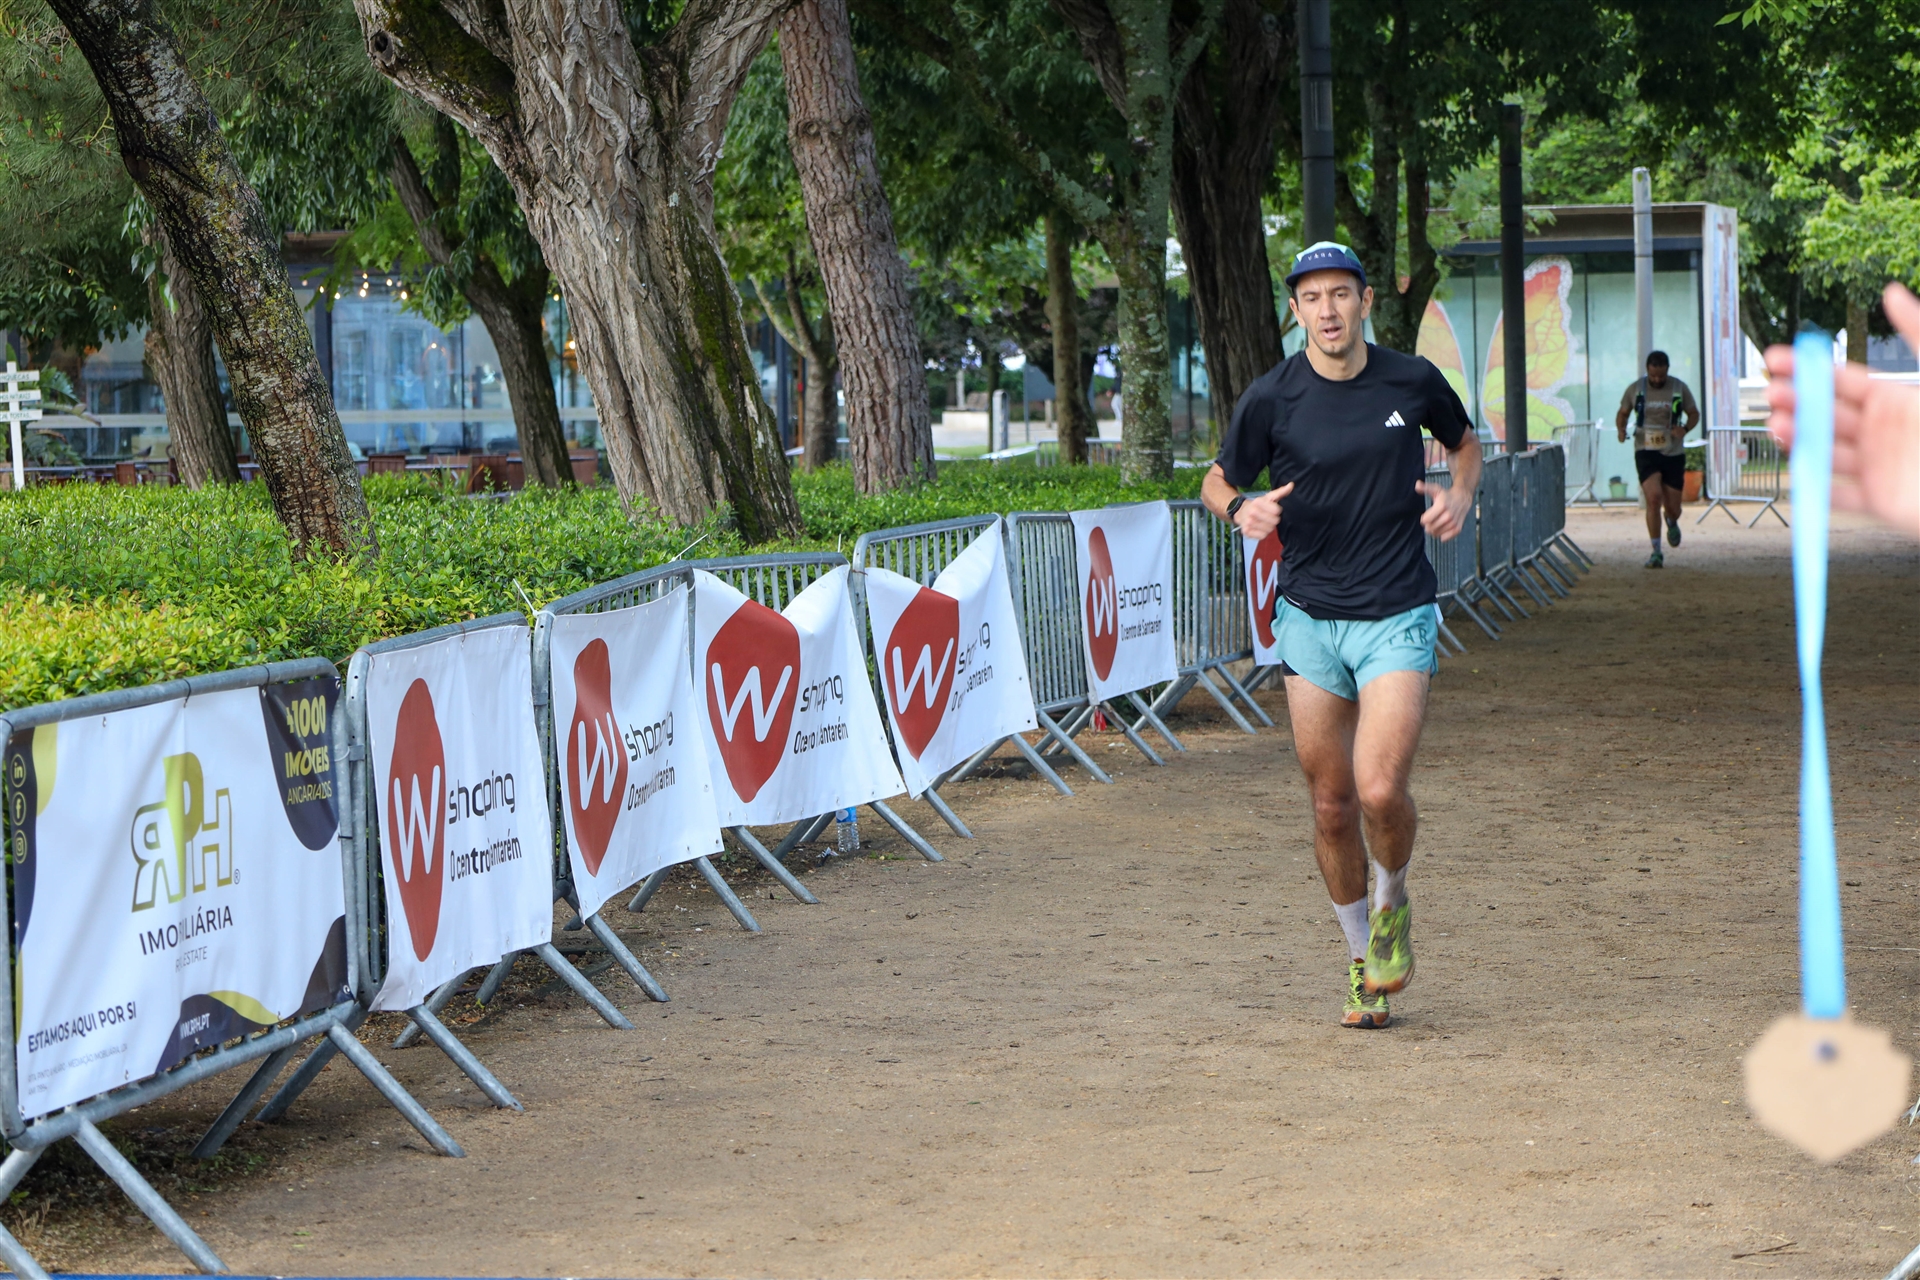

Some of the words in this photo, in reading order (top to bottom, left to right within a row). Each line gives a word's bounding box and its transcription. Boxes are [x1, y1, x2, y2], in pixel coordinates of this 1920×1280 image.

[1092, 574, 1114, 638] W
[1119, 581, 1161, 610] shopping
[711, 662, 793, 742] W
[893, 637, 954, 714] W
[578, 712, 619, 810] W
[394, 765, 441, 882] W
[449, 769, 515, 824] shoping
[628, 783, 635, 811] O
[450, 850, 455, 882] O
[489, 828, 522, 866] antarém
[28, 1021, 69, 1053] ESTAMOS
[71, 1013, 97, 1038] AQUI
[98, 1005, 126, 1028] POR
[127, 1001, 137, 1020] SI
